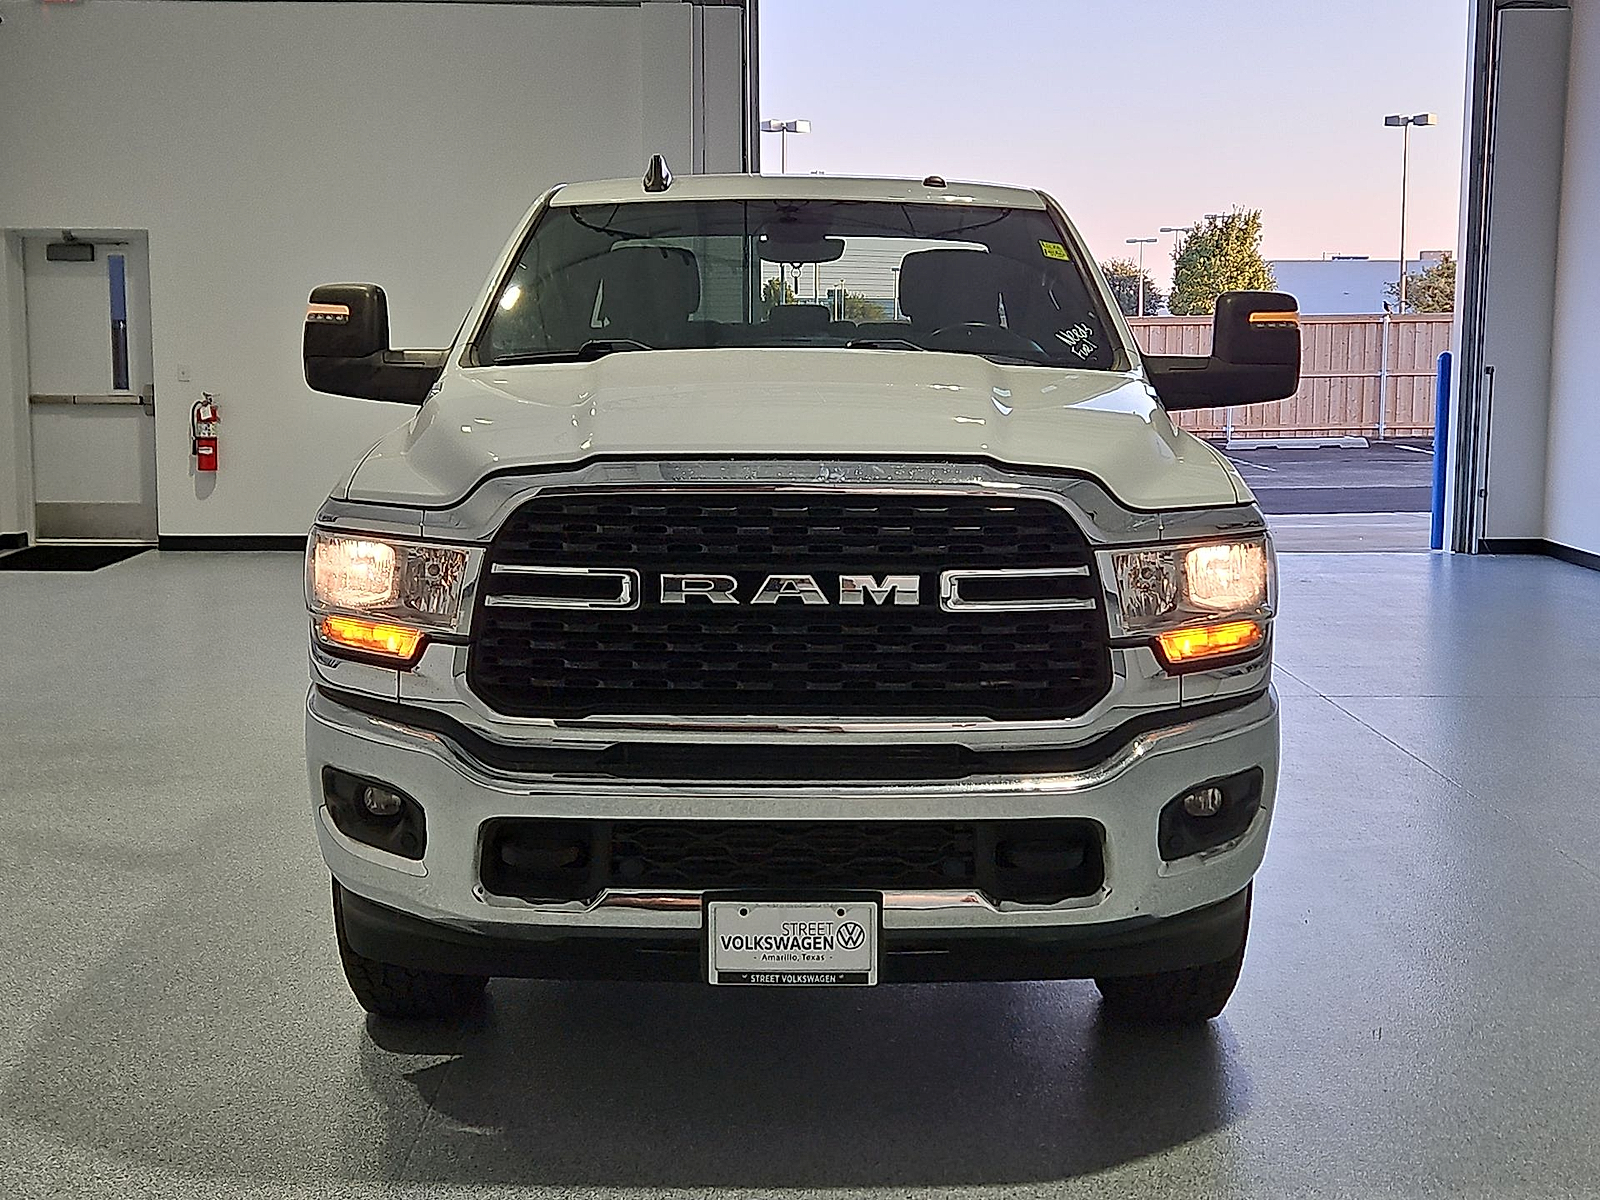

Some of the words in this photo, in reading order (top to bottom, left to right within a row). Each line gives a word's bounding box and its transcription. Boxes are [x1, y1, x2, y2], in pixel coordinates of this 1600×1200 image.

[660, 573, 920, 605] RAM
[781, 922, 834, 936] STREET
[720, 935, 834, 950] VOLKSWAGEN
[761, 953, 800, 962] Amarillo,
[802, 953, 826, 961] Texas
[750, 974, 780, 983] STREET
[781, 974, 837, 983] VOLKSWAGEN
